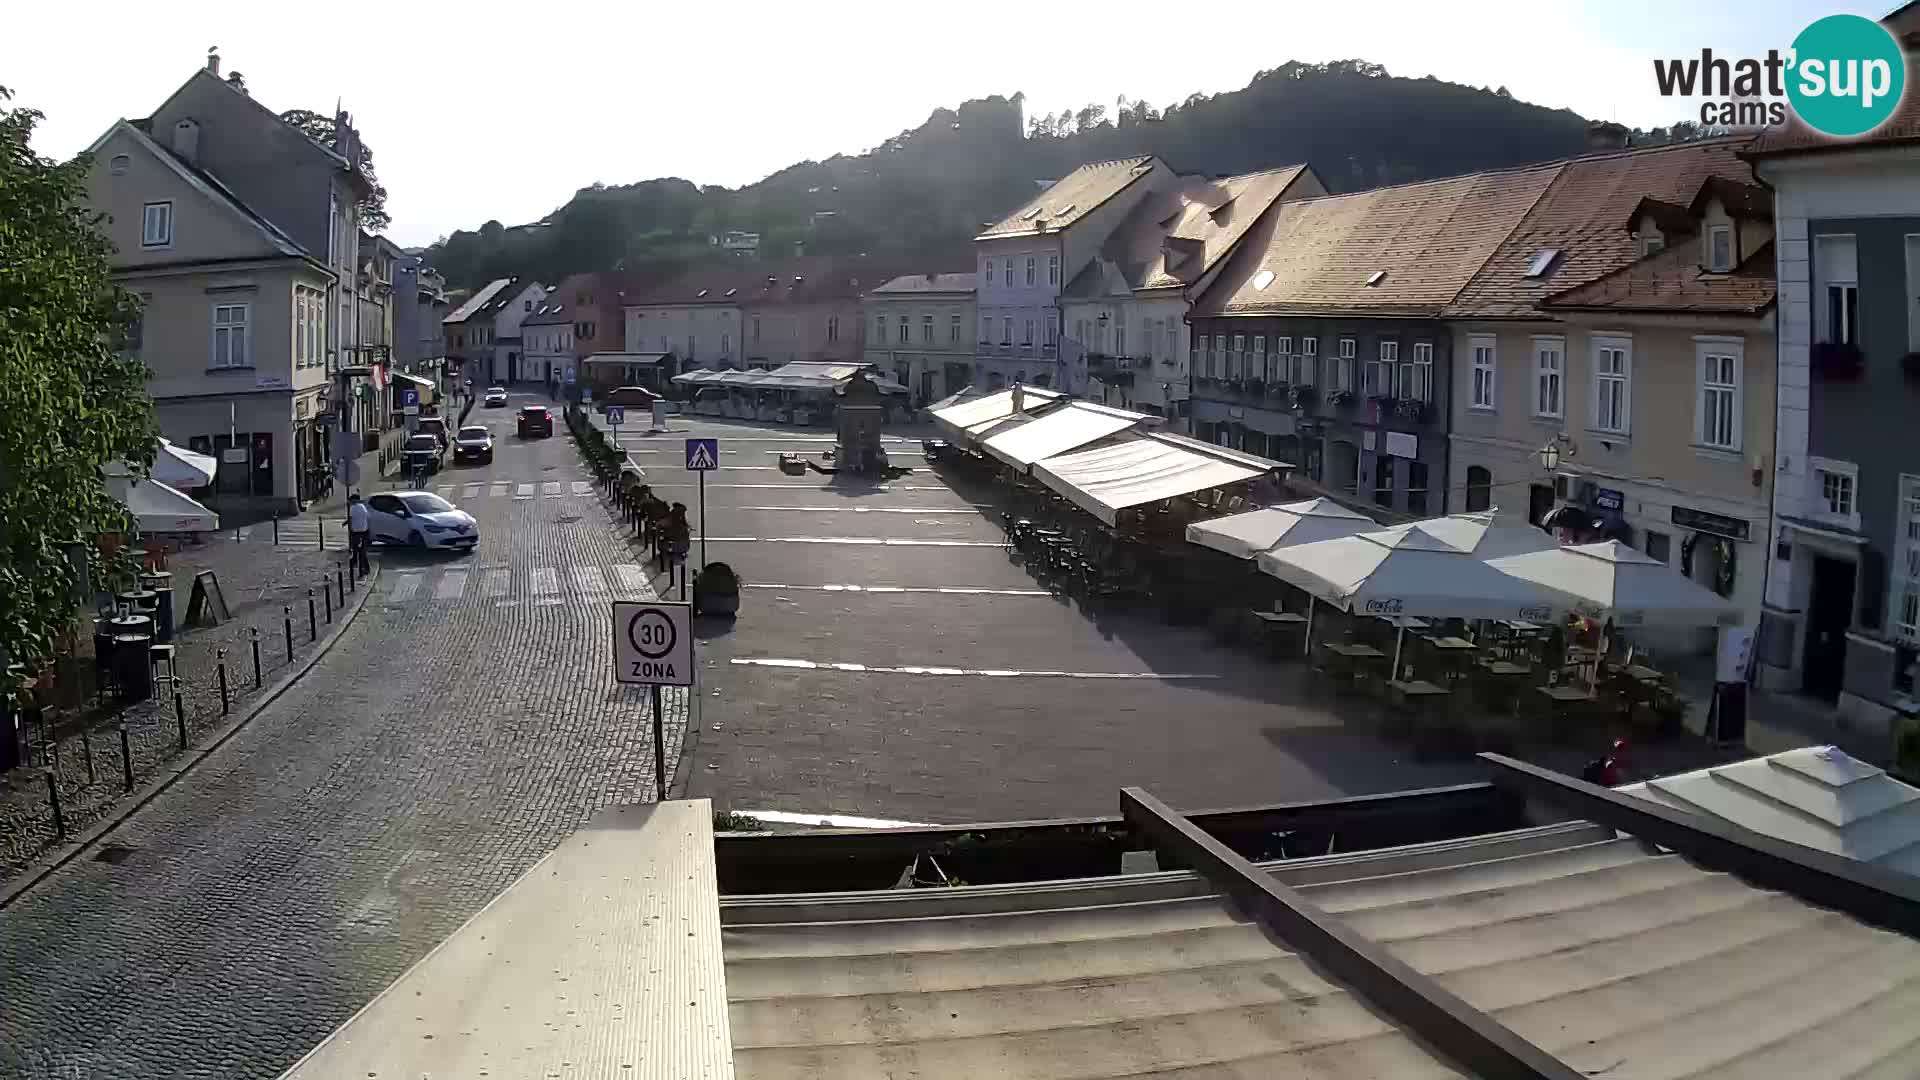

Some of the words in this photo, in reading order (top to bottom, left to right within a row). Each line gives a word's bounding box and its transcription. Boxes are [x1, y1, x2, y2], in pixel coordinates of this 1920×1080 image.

[407, 392, 415, 403] P
[641, 624, 665, 645] 30
[631, 661, 676, 677] ZONA
